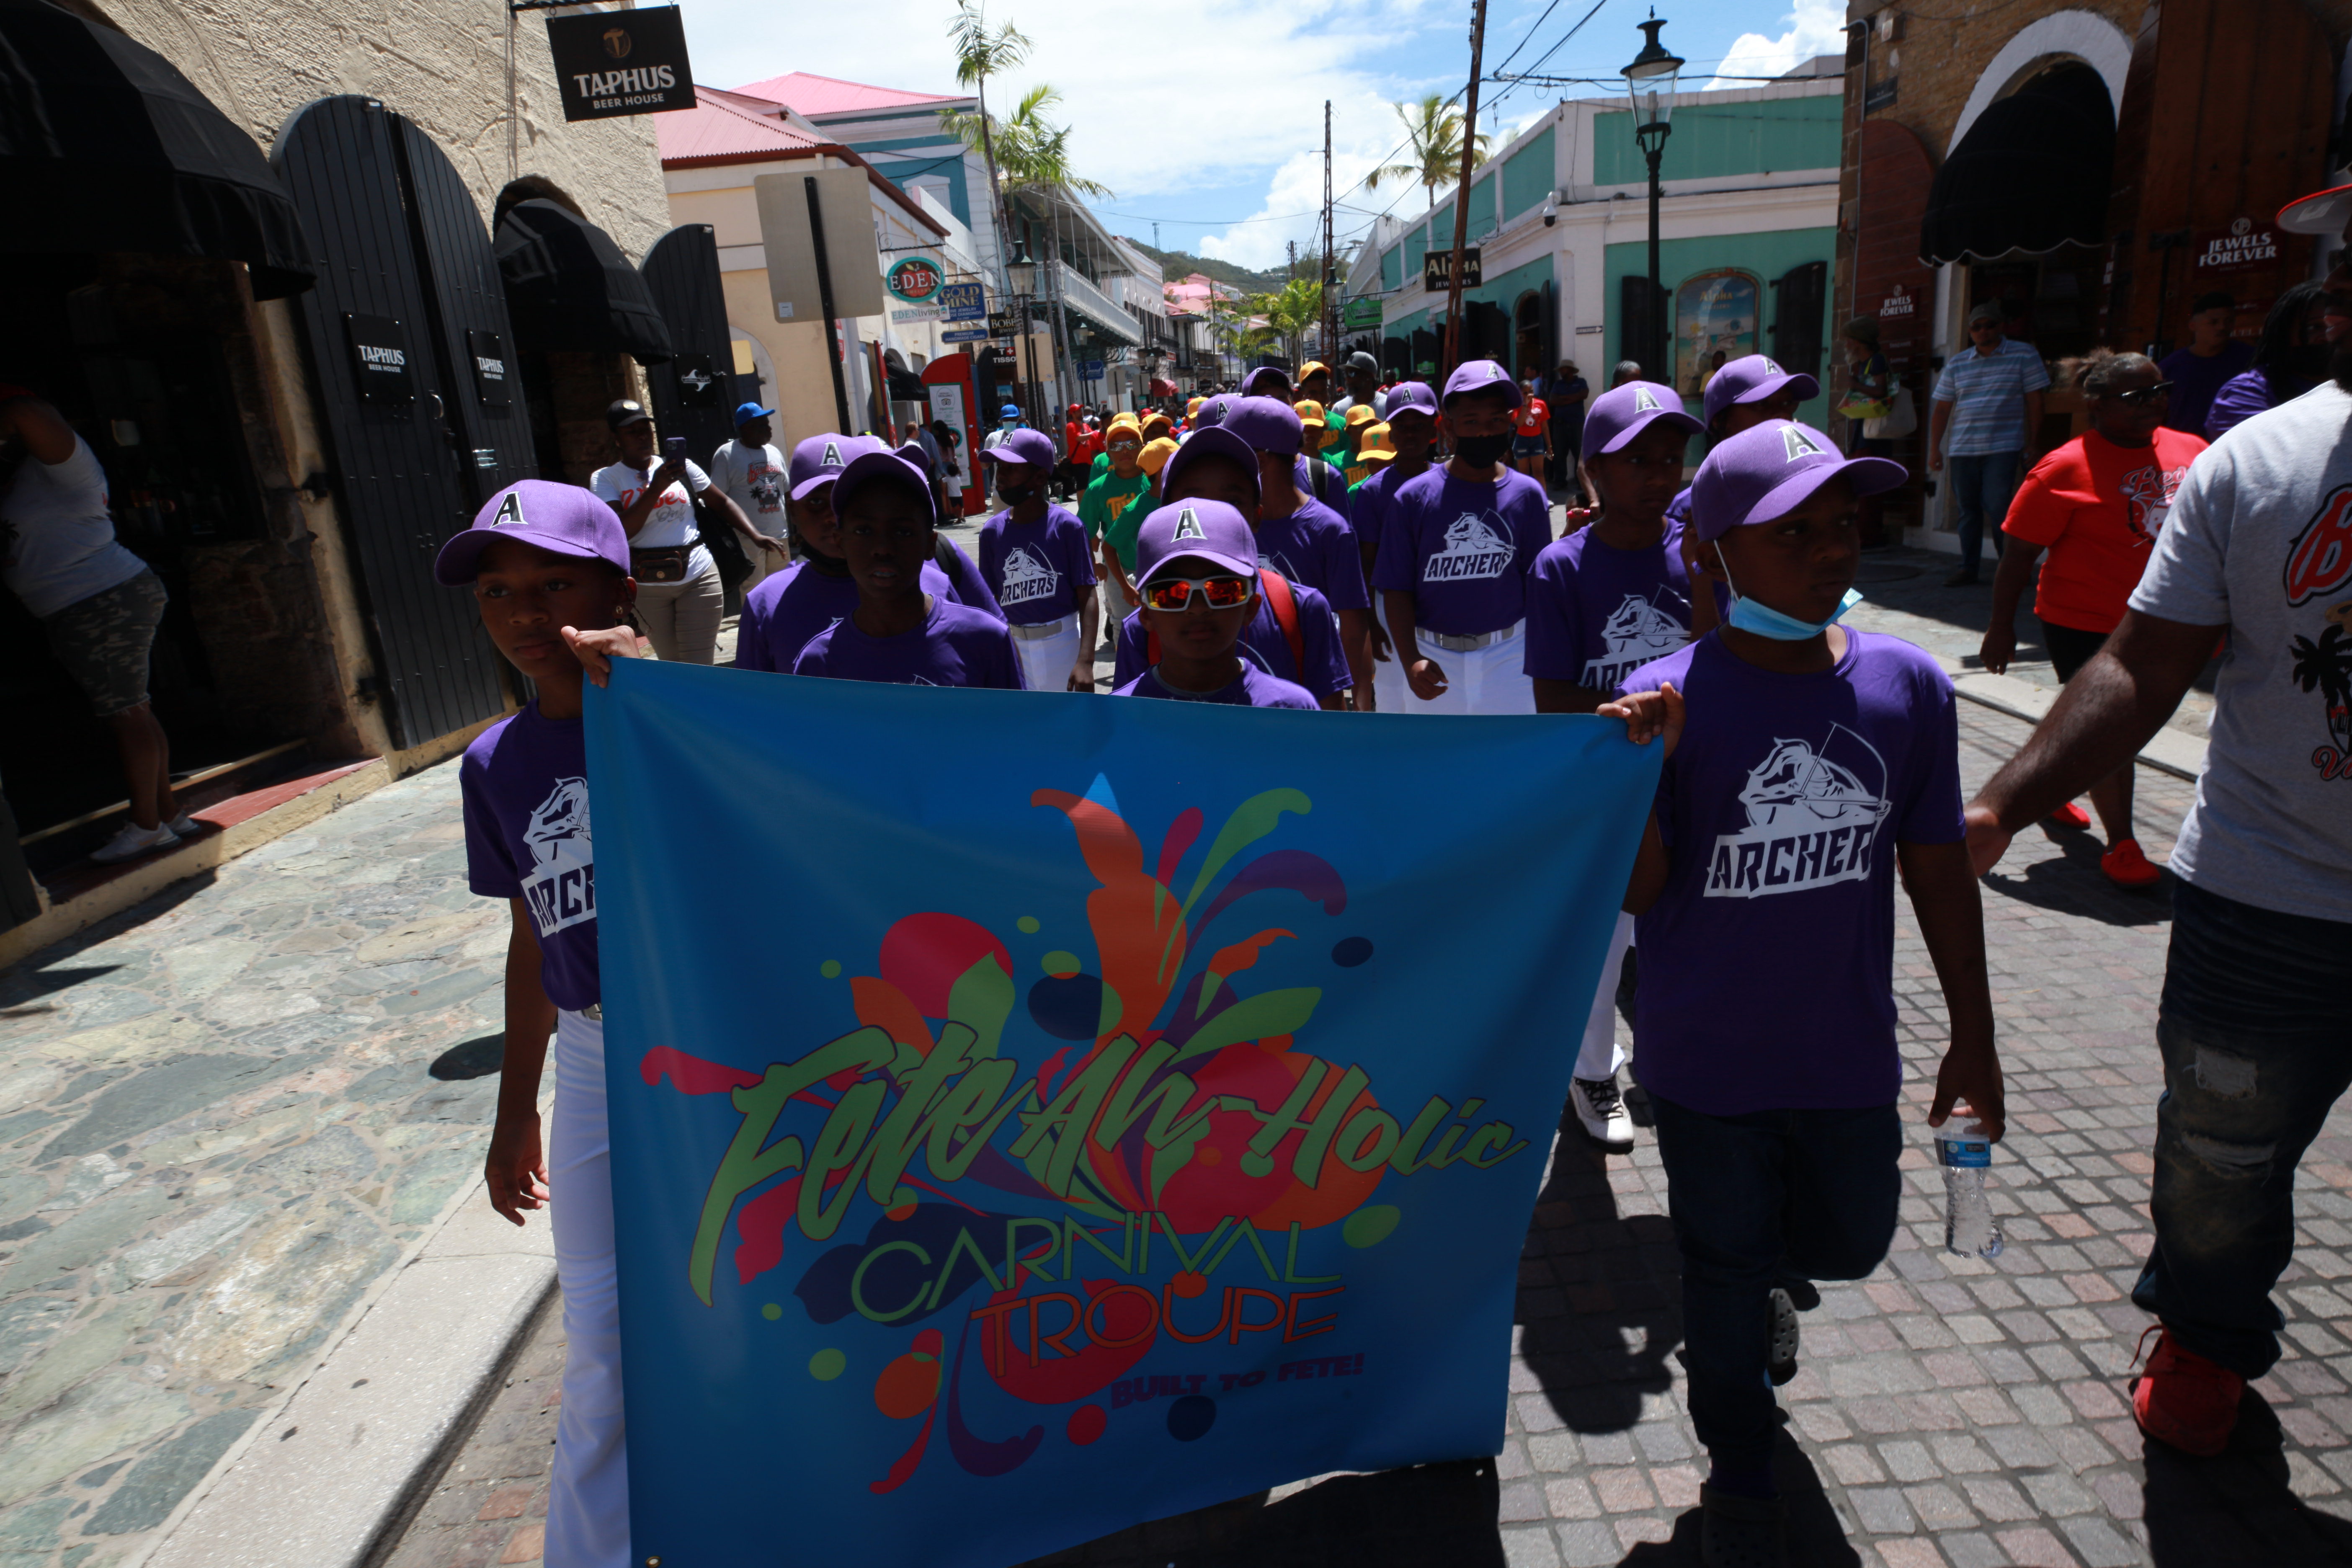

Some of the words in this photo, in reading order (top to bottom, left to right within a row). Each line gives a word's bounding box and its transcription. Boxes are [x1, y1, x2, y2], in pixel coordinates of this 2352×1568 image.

[573, 65, 675, 97] TAPHUS
[593, 98, 622, 109] BEER
[625, 93, 664, 105] HOUSE
[2208, 232, 2272, 255] JEWELS
[2199, 245, 2277, 267] FOREVER
[889, 271, 942, 291] EDEN
[1436, 279, 1472, 289] JEWRS
[940, 286, 980, 299] GOLD
[944, 295, 980, 307] MINE
[1883, 295, 1911, 308] JEWELS
[1347, 306, 1381, 322] Renaissance
[1880, 304, 1914, 317] FOREVER
[990, 318, 1016, 329] BOBB
[358, 345, 405, 365] TAPHUS
[477, 356, 504, 373] TAPHUS
[1485, 364, 1501, 380] A
[1761, 357, 1781, 376] A
[1400, 387, 1414, 403] A
[1634, 387, 1664, 414] A
[1304, 406, 1313, 416] T
[1001, 432, 1015, 446] A
[1371, 434, 1381, 446] T
[1776, 424, 1828, 464] A
[820, 442, 847, 467] A
[490, 491, 529, 529] A
[1170, 507, 1208, 544] A
[1710, 822, 1877, 892] ARCHER
[851, 1210, 1341, 1323] CARNIVAL
[970, 1283, 1346, 1379] TROUPE
[1110, 1374, 1208, 1410] BUILT
[1218, 1370, 1267, 1392] TO
[1277, 1353, 1366, 1383] FETE!
